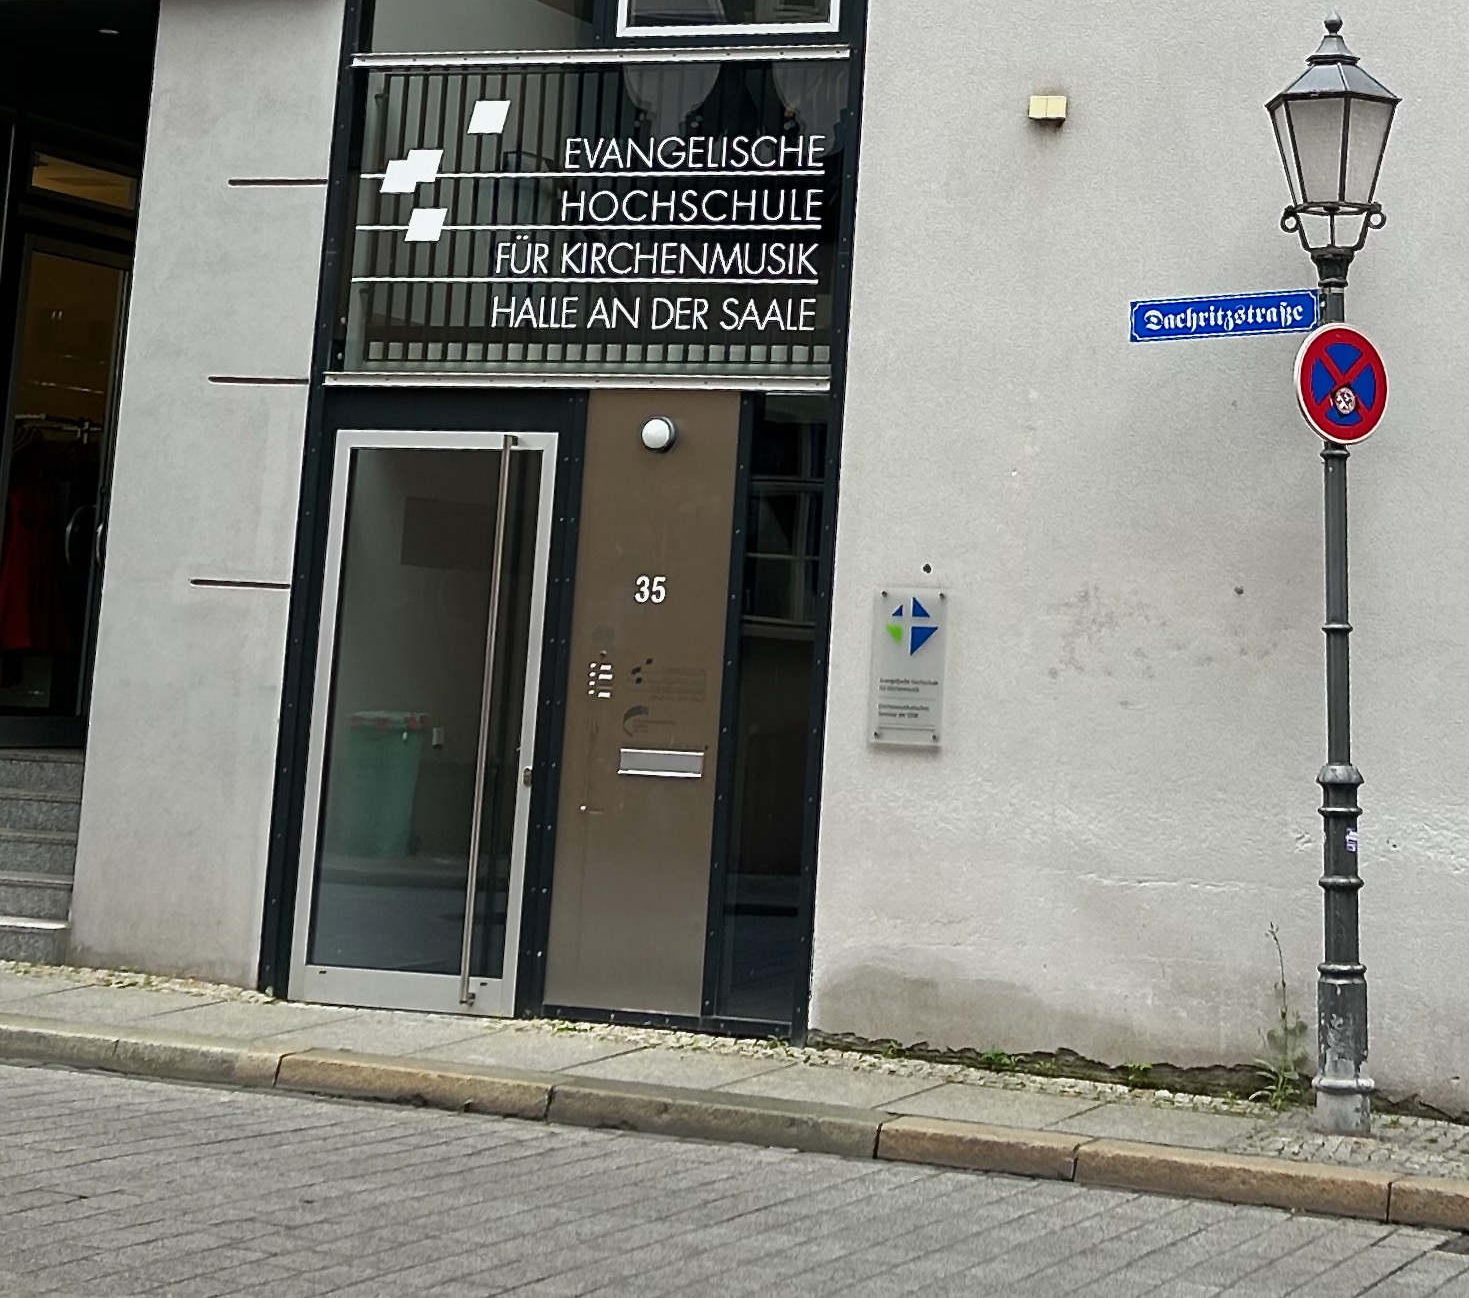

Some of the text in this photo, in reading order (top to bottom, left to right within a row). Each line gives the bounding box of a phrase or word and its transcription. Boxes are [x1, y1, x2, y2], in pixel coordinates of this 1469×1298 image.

[564, 135, 826, 169] EVANGELISCHE
[561, 188, 824, 222] HOCHSCHULE
[495, 234, 819, 275] FÜR KIRCHENMUSIK
[490, 295, 817, 332] HALLE AN DER SAALE
[1143, 301, 1305, 333] Dachritzstraße
[633, 574, 668, 604] 35
